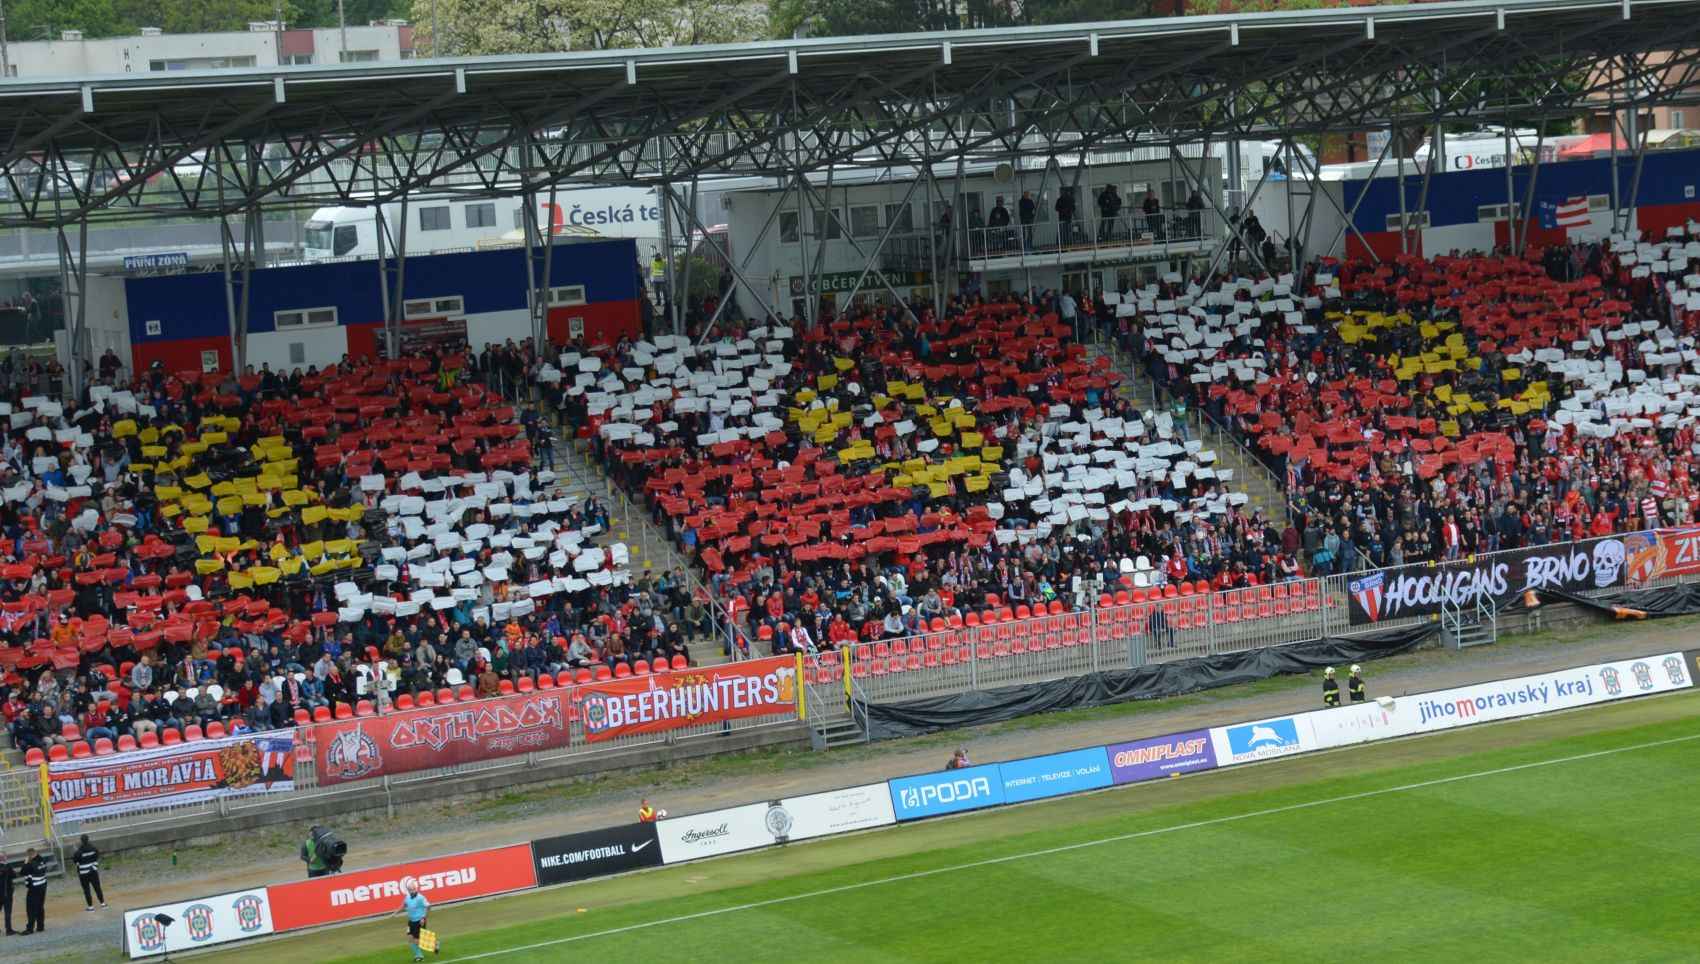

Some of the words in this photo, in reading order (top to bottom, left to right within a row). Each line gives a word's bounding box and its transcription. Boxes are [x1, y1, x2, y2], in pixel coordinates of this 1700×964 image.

[569, 203, 635, 226] Česká
[1385, 560, 1509, 617] HOOLIGANS
[1515, 545, 1590, 593] BRNO
[606, 673, 779, 728] BEERHUNTERS
[1418, 681, 1549, 724] jihomoravský
[1554, 674, 1593, 696] kraj
[388, 696, 563, 752] ORTHODOX
[1114, 738, 1207, 768] OMNIPLAST
[1232, 752, 1257, 761] NOVA
[50, 774, 117, 804] SOUTH
[920, 776, 991, 807] PODA
[1005, 776, 1037, 788] INTERNET
[1041, 771, 1072, 782] TELEVIZE
[681, 822, 730, 844] Ingersoll
[540, 844, 626, 869] NIKE.COM/FOOTBALL
